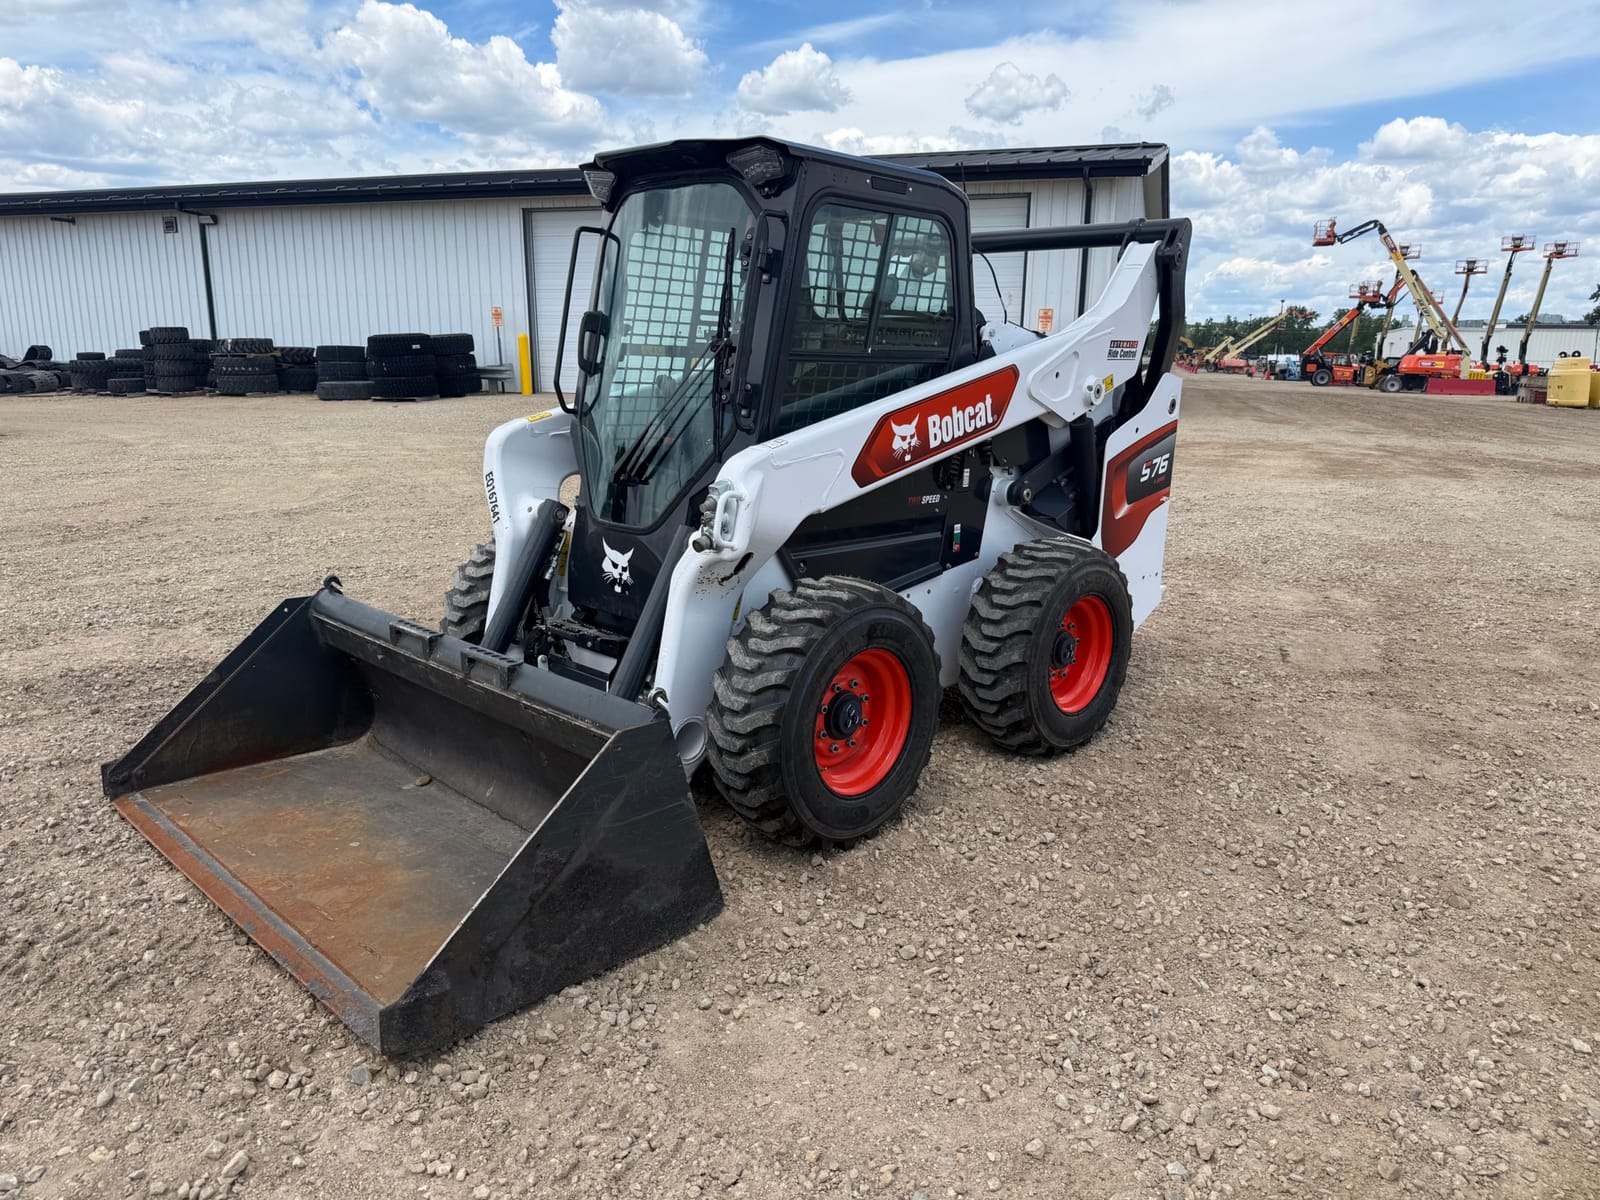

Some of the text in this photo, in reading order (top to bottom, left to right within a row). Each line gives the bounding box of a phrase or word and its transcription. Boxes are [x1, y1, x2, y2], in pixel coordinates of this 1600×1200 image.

[1107, 349, 1137, 358] Ride Control
[928, 394, 993, 448] Bobcat
[1140, 453, 1170, 482] S76
[485, 471, 500, 524] EQ167641
[921, 494, 940, 504] SPEED
